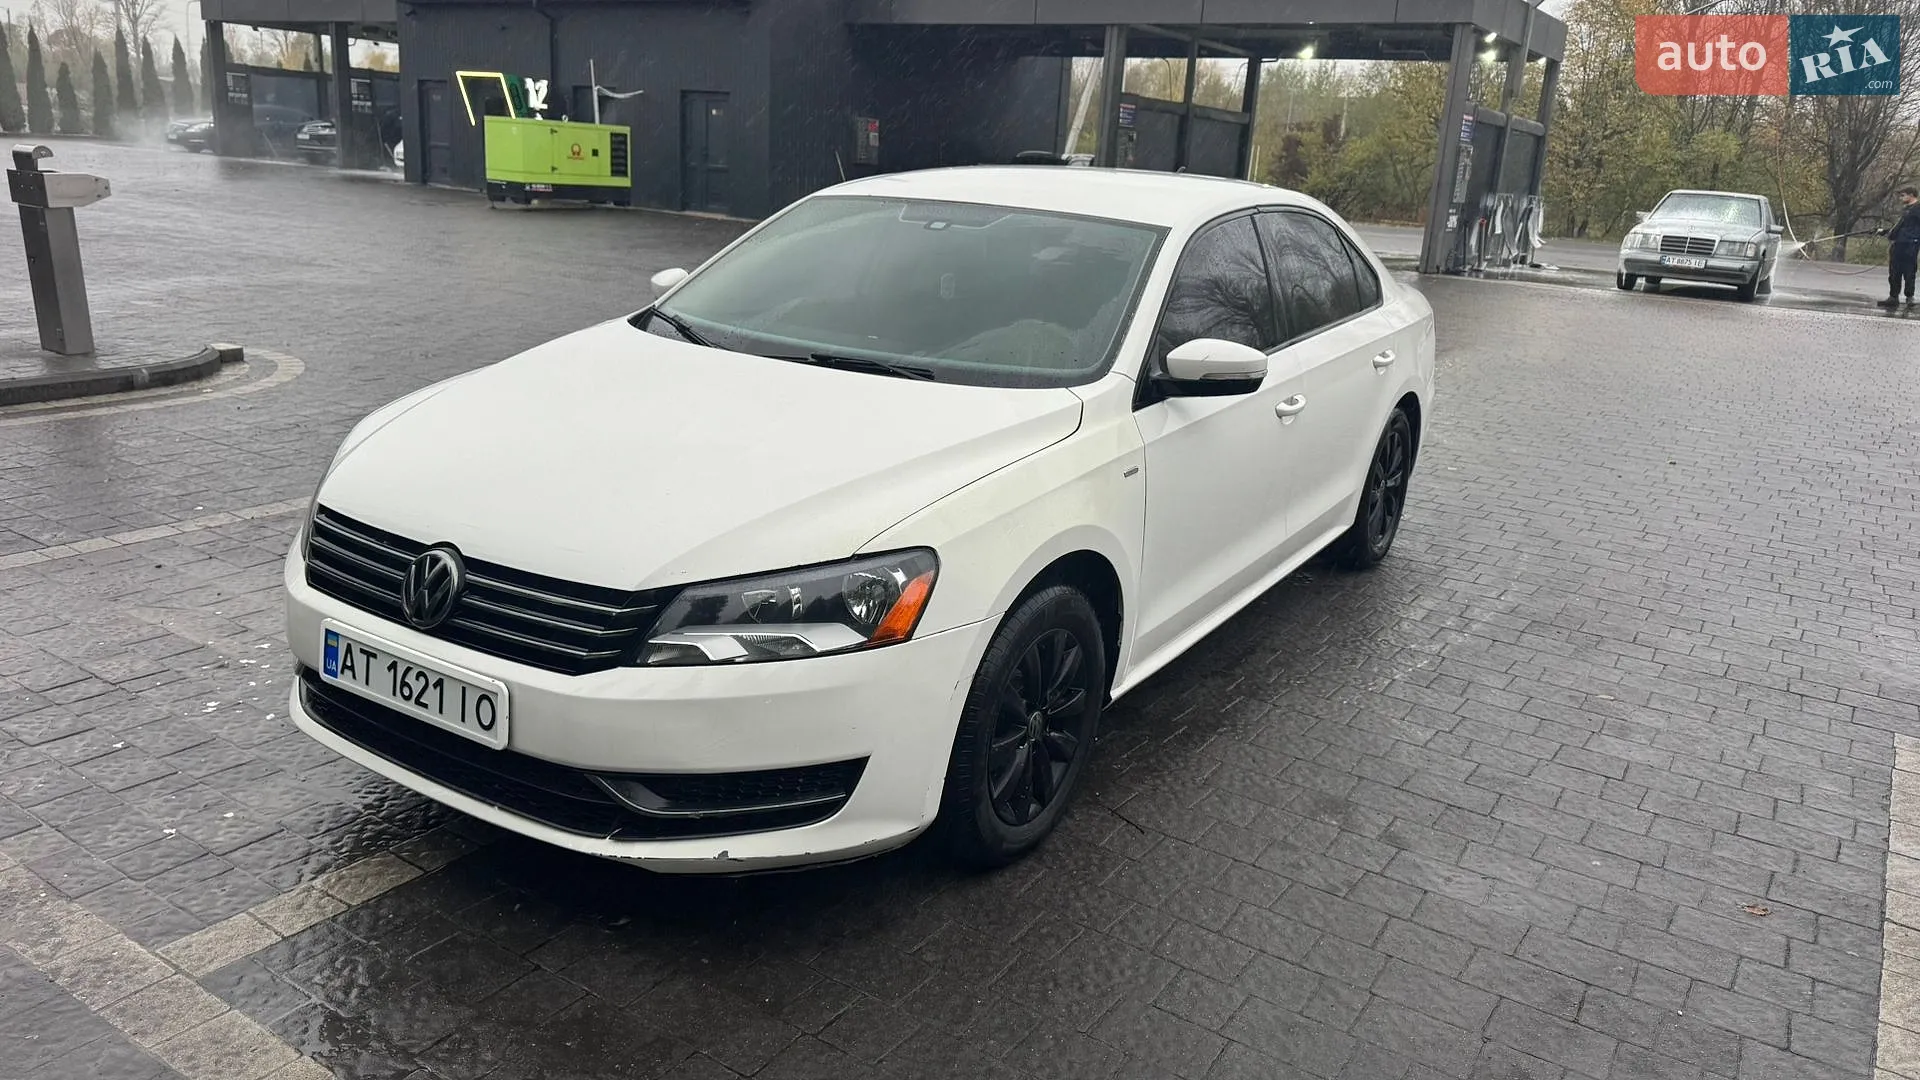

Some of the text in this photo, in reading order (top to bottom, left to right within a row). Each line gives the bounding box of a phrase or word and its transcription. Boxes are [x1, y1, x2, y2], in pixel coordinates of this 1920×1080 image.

[326, 657, 337, 671] UA
[340, 642, 497, 731] AT 1621 IO
